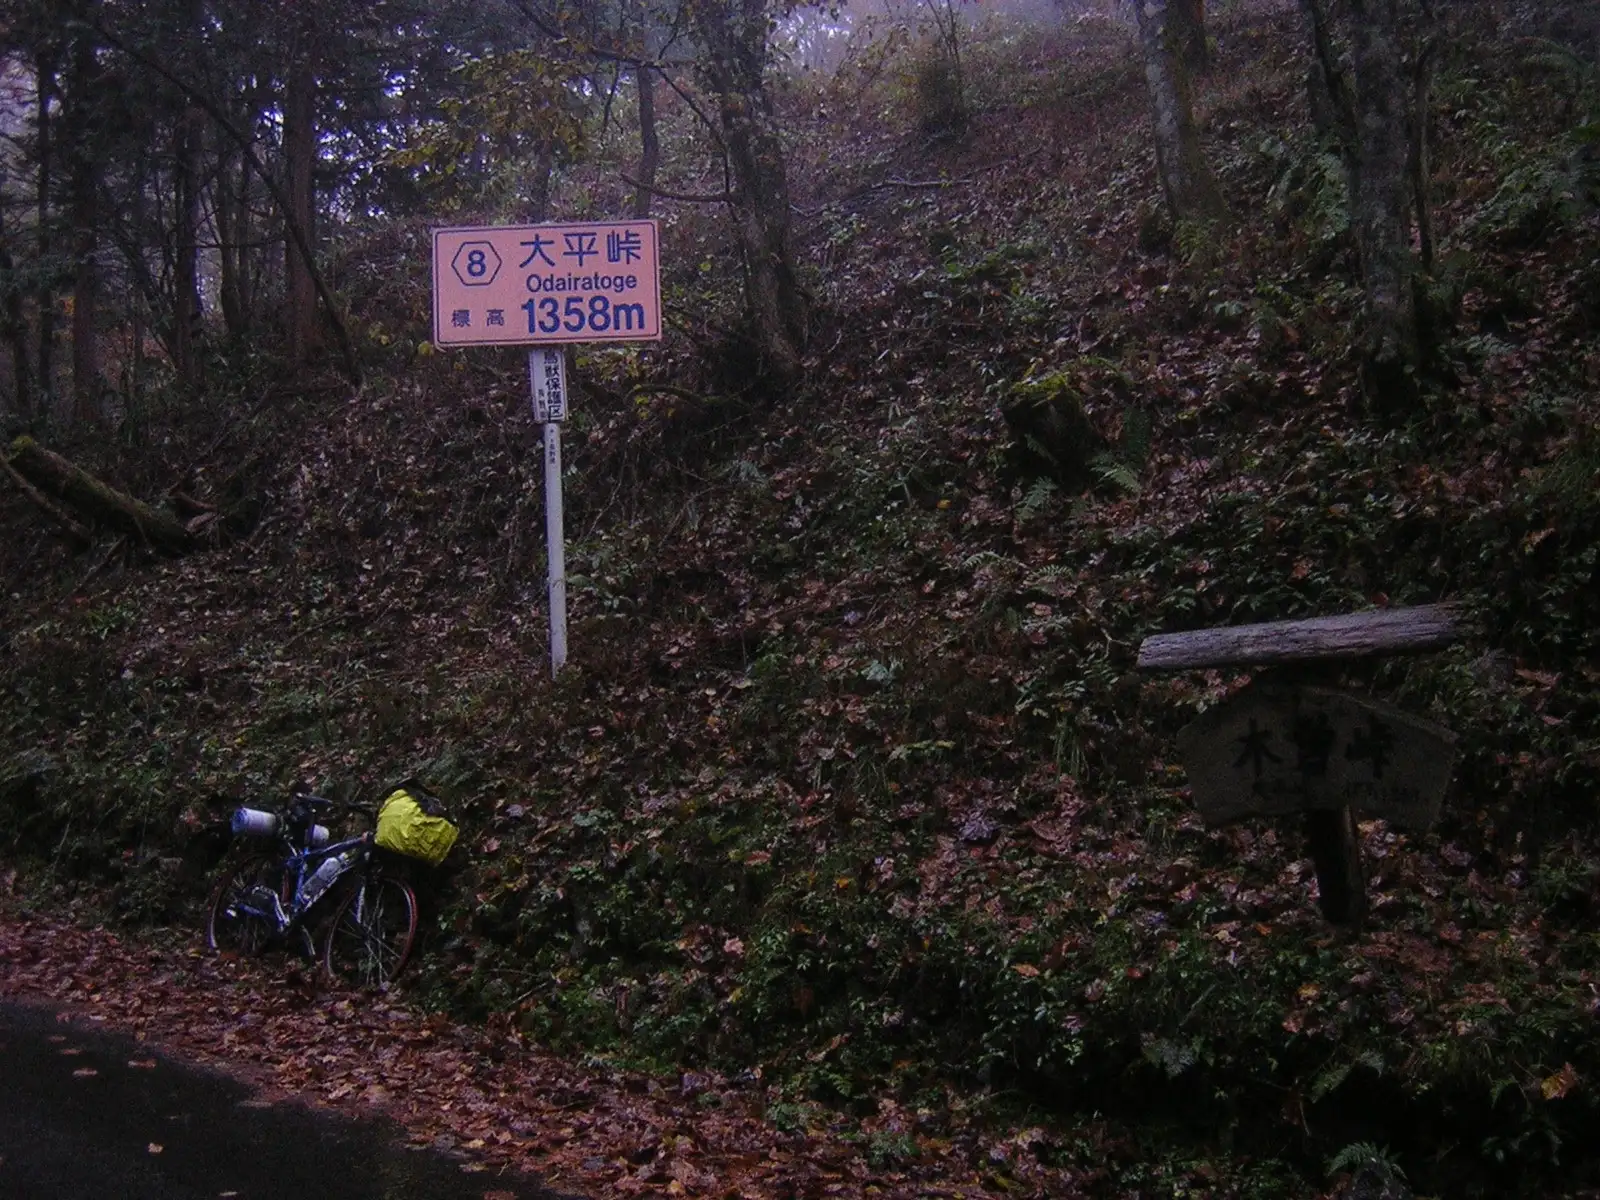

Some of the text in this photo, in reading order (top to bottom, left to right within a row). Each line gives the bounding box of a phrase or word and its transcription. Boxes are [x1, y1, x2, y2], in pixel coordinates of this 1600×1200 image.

[466, 249, 487, 277] 8
[519, 229, 642, 268] 大平峠
[526, 273, 638, 293] Odairatoge
[450, 295, 645, 334] 標高 1358m
